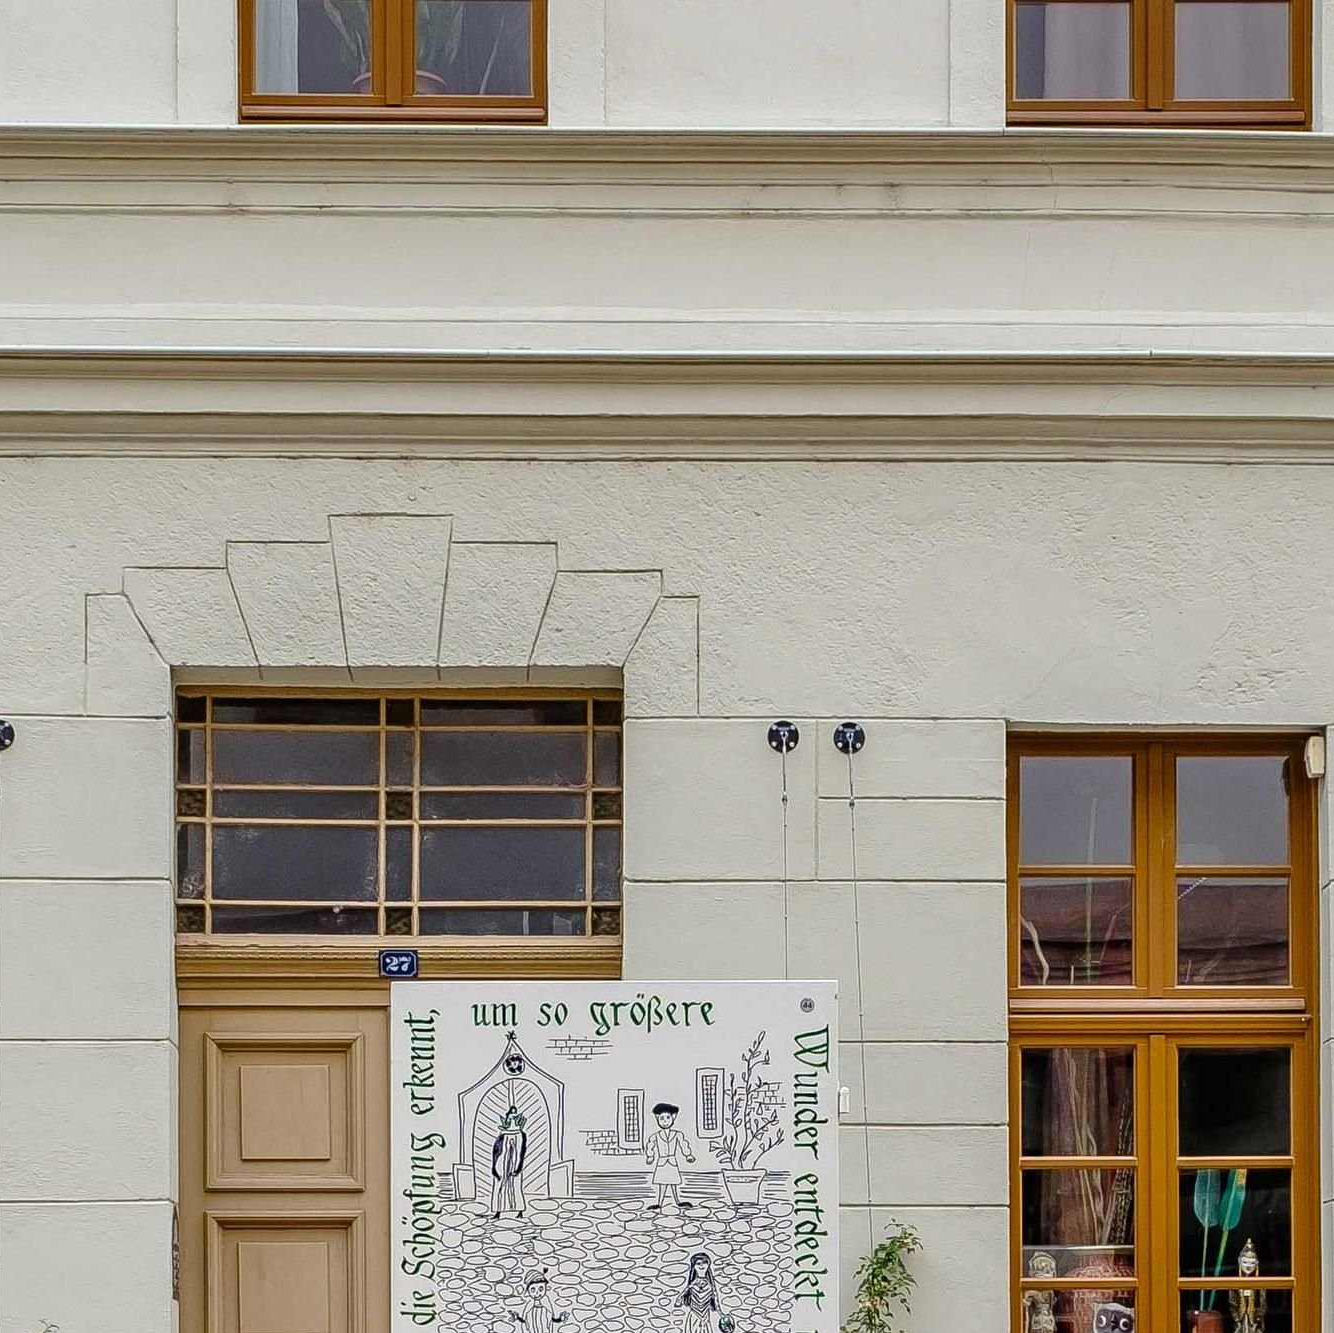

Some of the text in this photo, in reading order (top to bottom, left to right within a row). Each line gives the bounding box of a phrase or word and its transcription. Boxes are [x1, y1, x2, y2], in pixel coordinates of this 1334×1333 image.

[386, 956, 411, 971] 27
[471, 993, 716, 1036] um so größere
[402, 1008, 441, 1115] erkennt,
[793, 1024, 830, 1160] Wunder
[400, 1133, 446, 1281] Schöpfung
[793, 1174, 828, 1312] entdeckt
[401, 1290, 437, 1326] die
